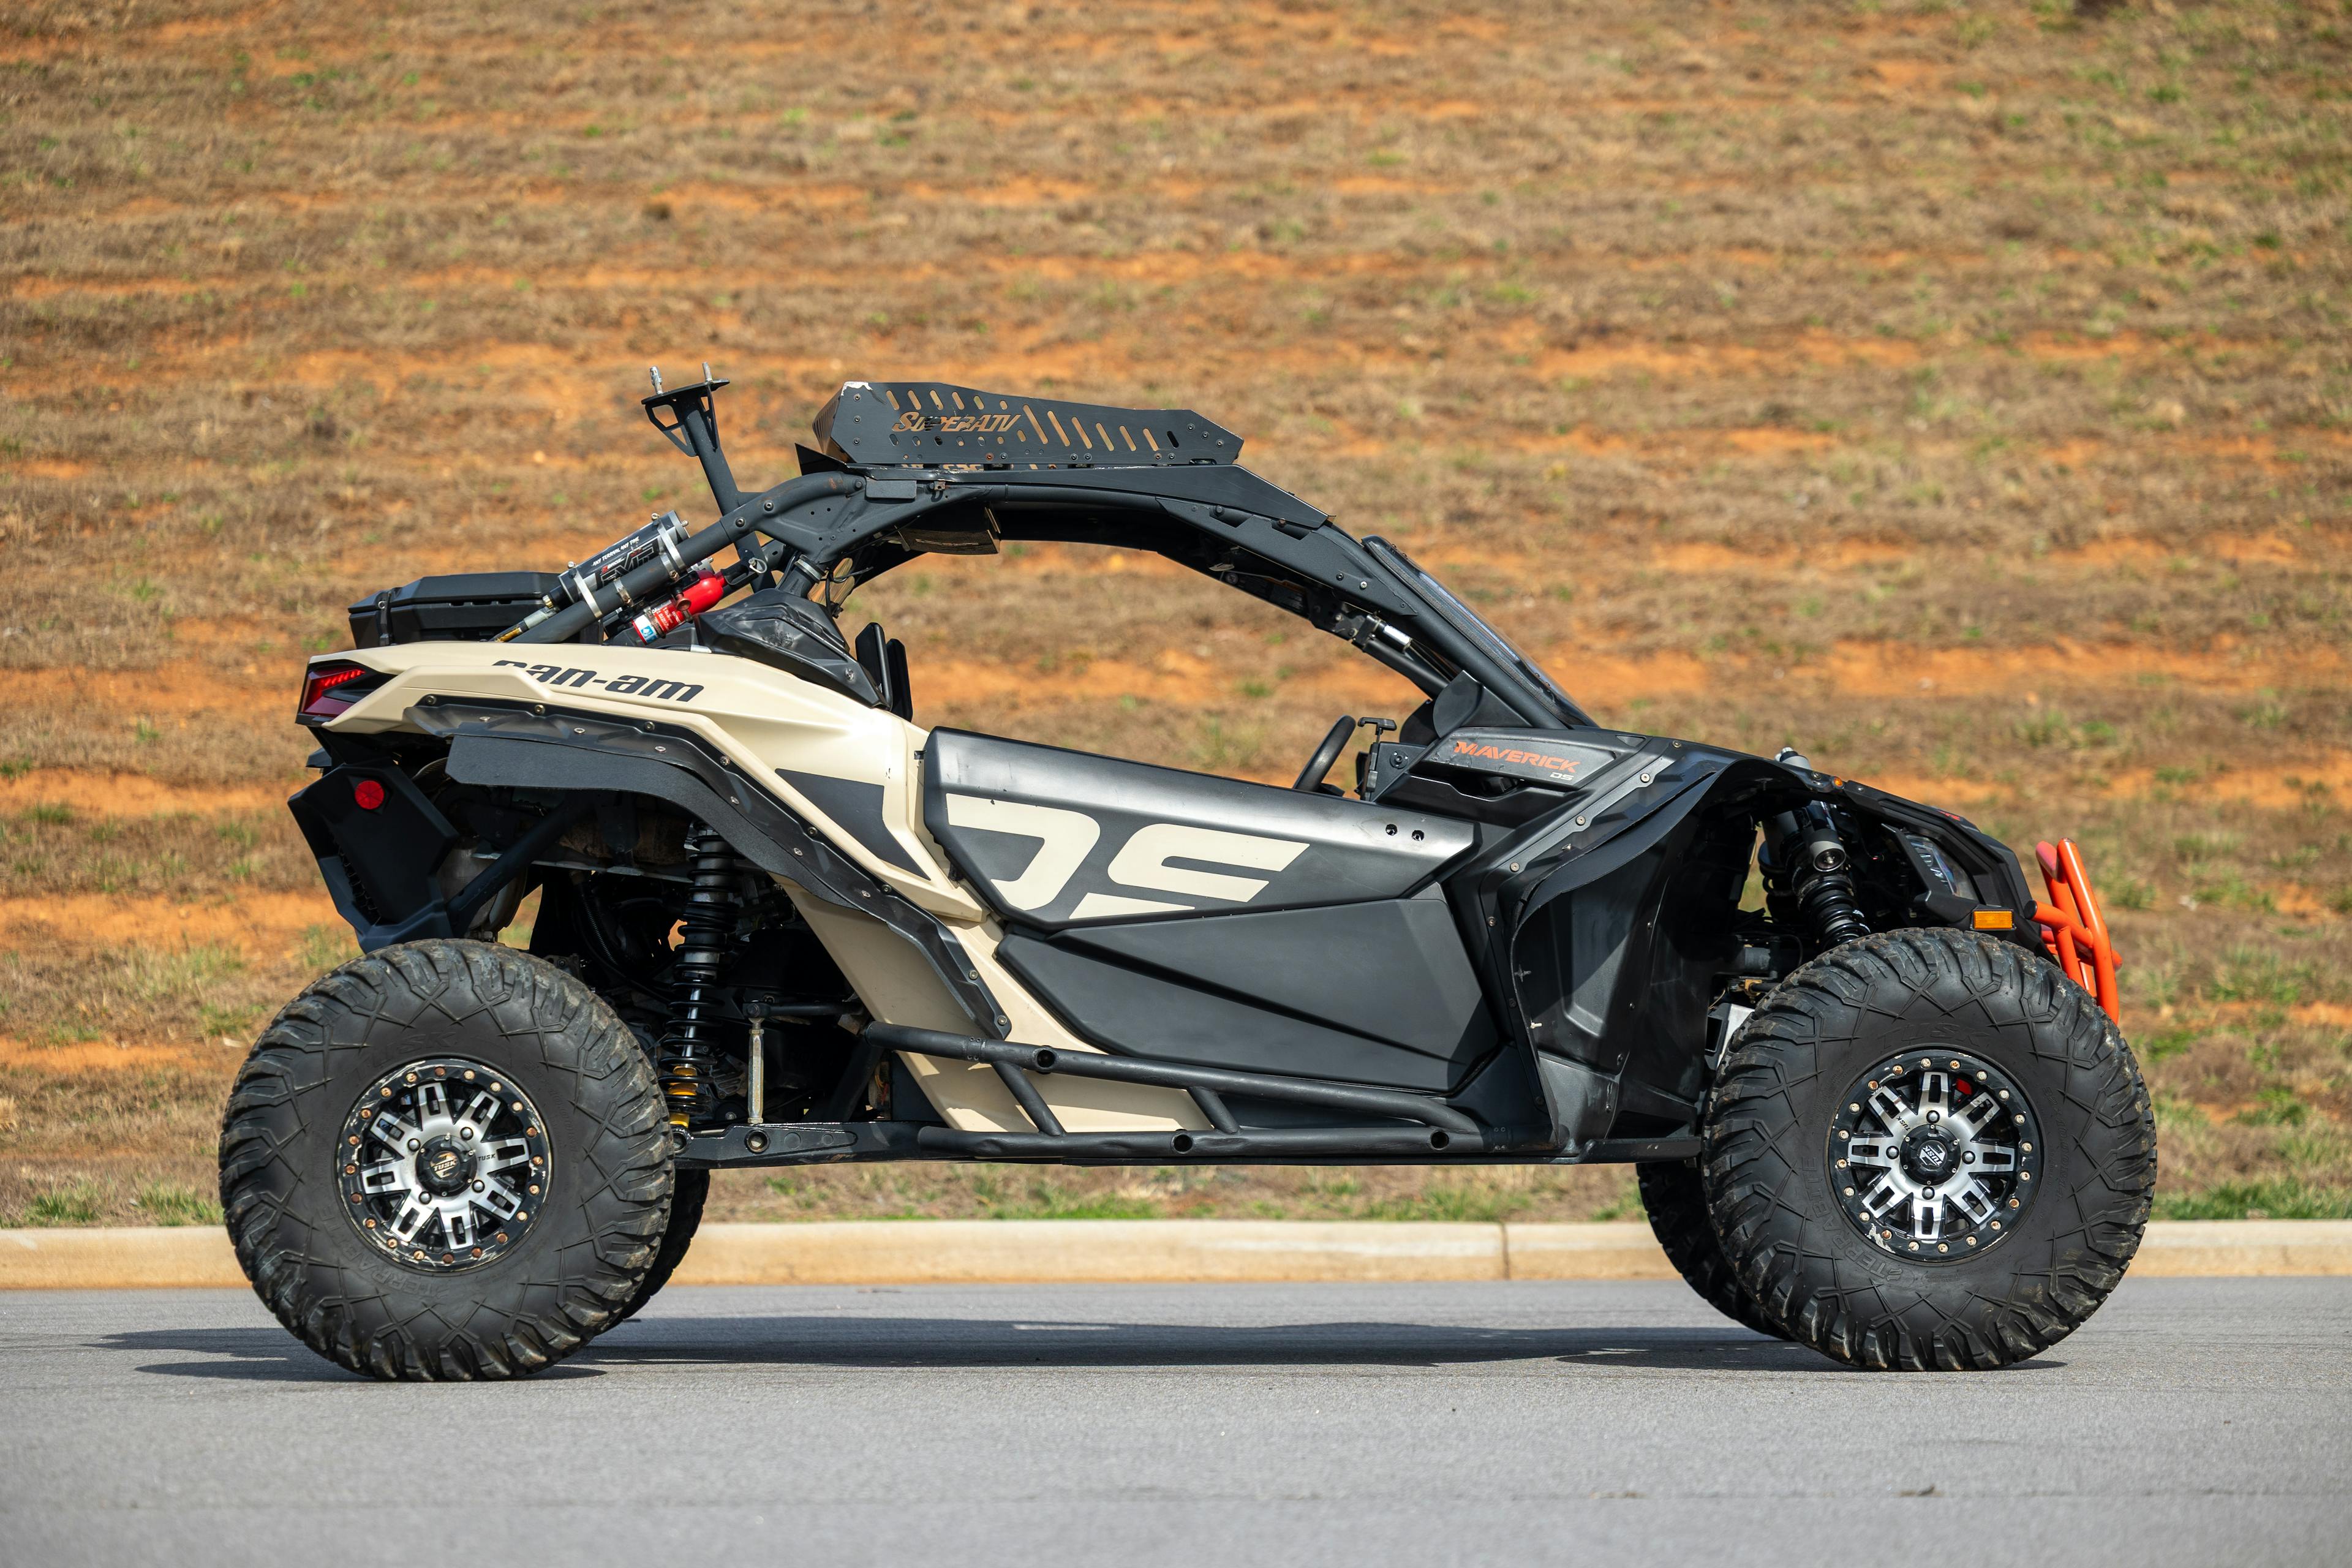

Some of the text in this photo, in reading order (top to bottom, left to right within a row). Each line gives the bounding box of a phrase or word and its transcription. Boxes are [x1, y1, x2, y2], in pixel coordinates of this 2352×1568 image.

[491, 660, 704, 703] an-am
[1454, 740, 1581, 773] MAVERICK
[1550, 772, 1574, 781] DS
[1896, 1115, 1912, 1131] TUSK
[478, 1153, 496, 1162] TUSK
[1922, 1145, 1943, 1166] TUSK
[434, 1158, 458, 1172] TUSK
[1802, 1156, 1887, 1278] TERRABITE
